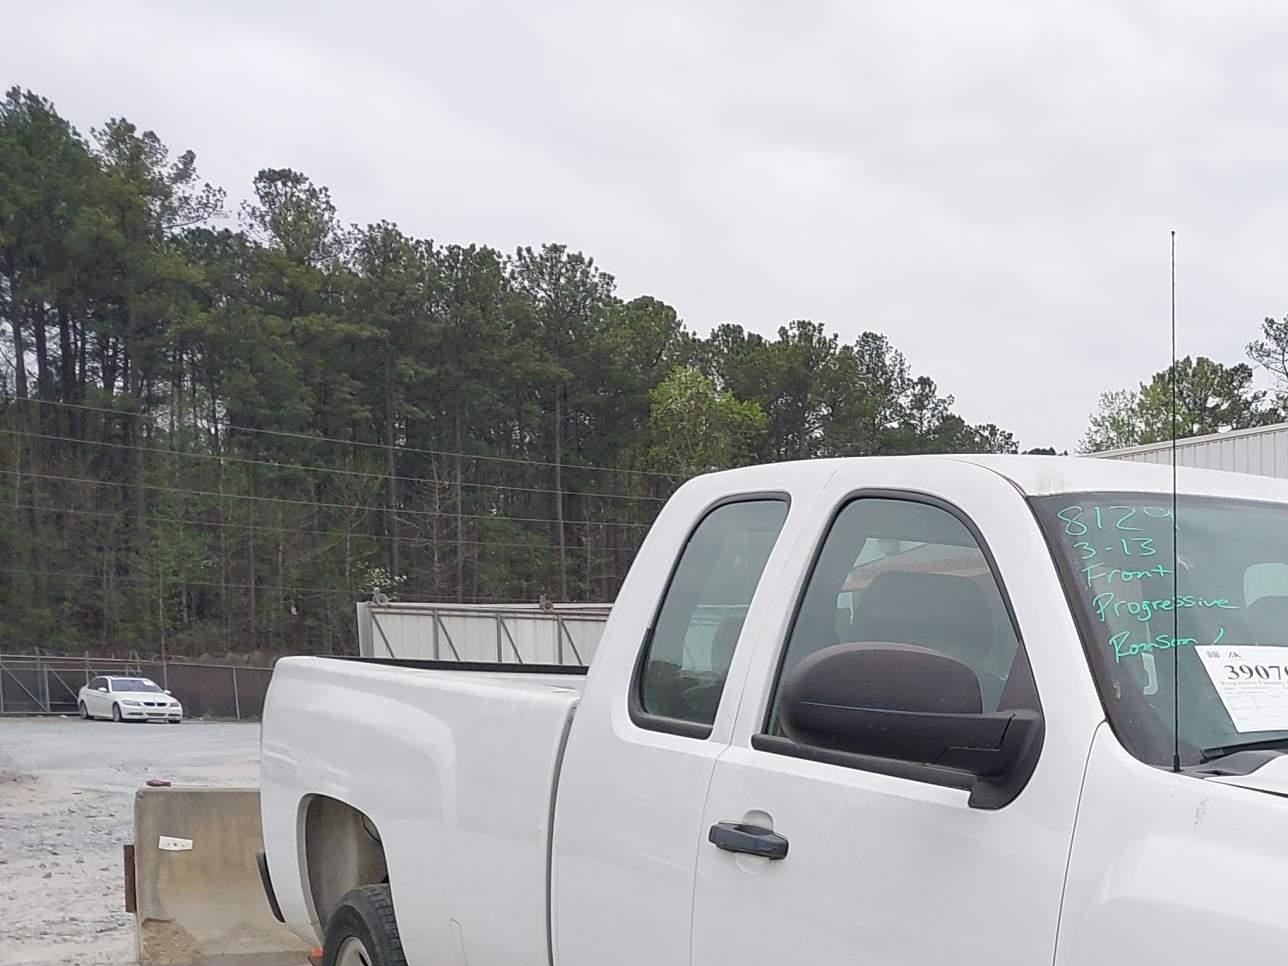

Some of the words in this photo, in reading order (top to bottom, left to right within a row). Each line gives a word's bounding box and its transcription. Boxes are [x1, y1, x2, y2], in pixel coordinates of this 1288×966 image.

[1073, 538, 1157, 560] 3-13
[1081, 562, 1174, 587] Front
[1093, 592, 1240, 622] Progressive
